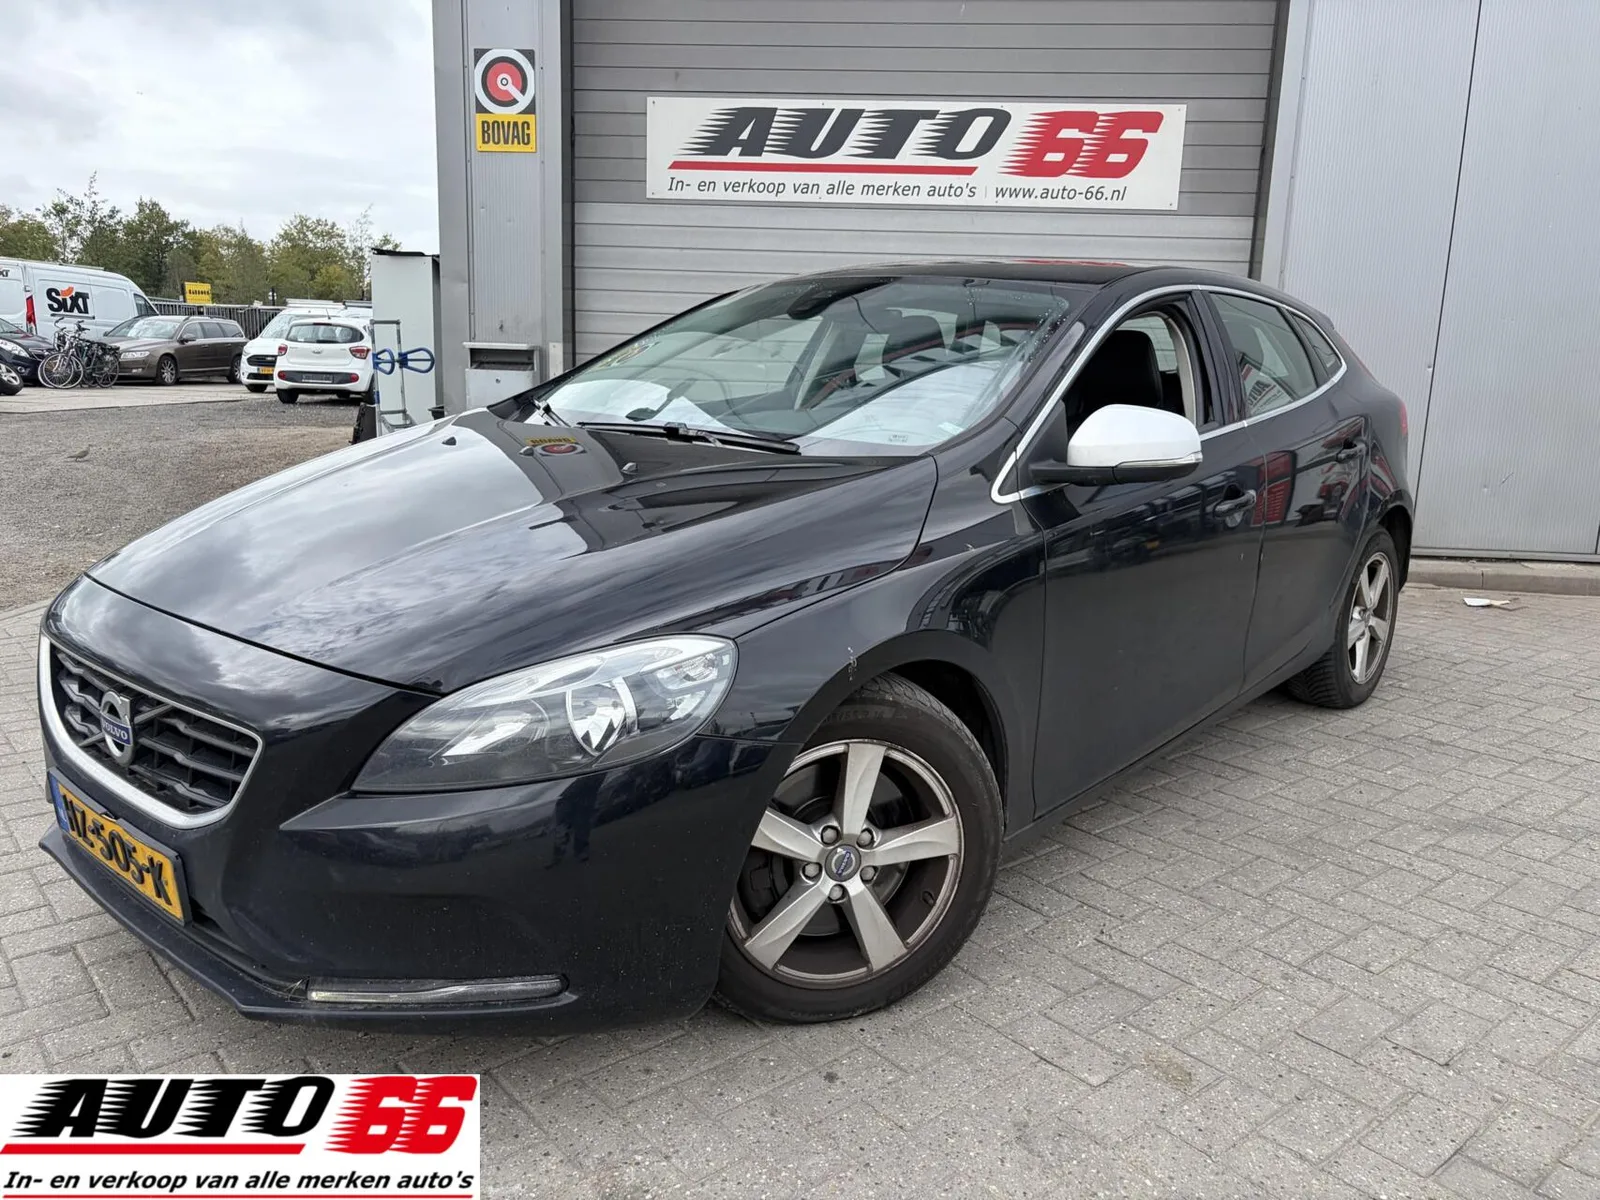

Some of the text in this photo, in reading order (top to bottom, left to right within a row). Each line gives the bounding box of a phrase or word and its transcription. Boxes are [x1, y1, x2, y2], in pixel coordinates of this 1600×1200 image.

[481, 120, 531, 145] BOVAG
[674, 106, 1164, 179] AUTO 66
[667, 177, 1128, 202] In- en verkoop van alle merken auto's www.auto-66.nl
